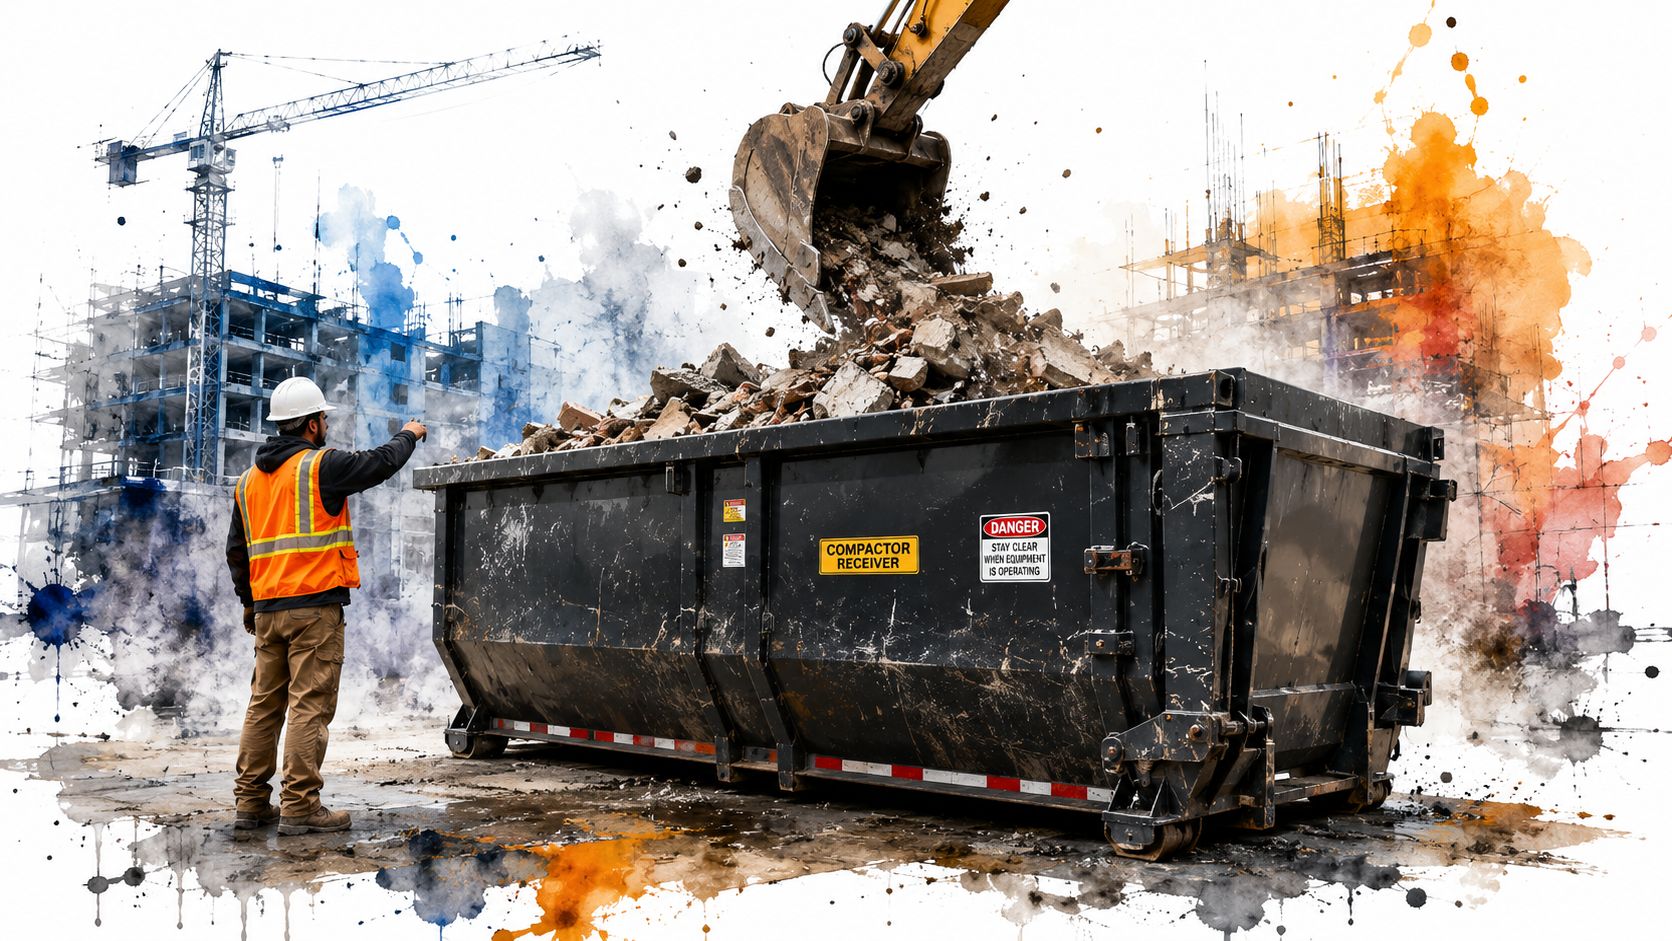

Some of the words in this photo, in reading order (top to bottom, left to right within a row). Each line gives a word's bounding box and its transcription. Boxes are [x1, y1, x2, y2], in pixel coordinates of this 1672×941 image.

[991, 520, 1040, 534] DANGER
[826, 542, 910, 556] COMPACTOR
[991, 542, 1010, 552] STAY
[1012, 541, 1038, 552] CLEAR
[837, 557, 899, 569] RECEIVER
[984, 554, 1004, 564] WHEN
[989, 566, 996, 576] IS
[998, 566, 1040, 576] OPERATING
